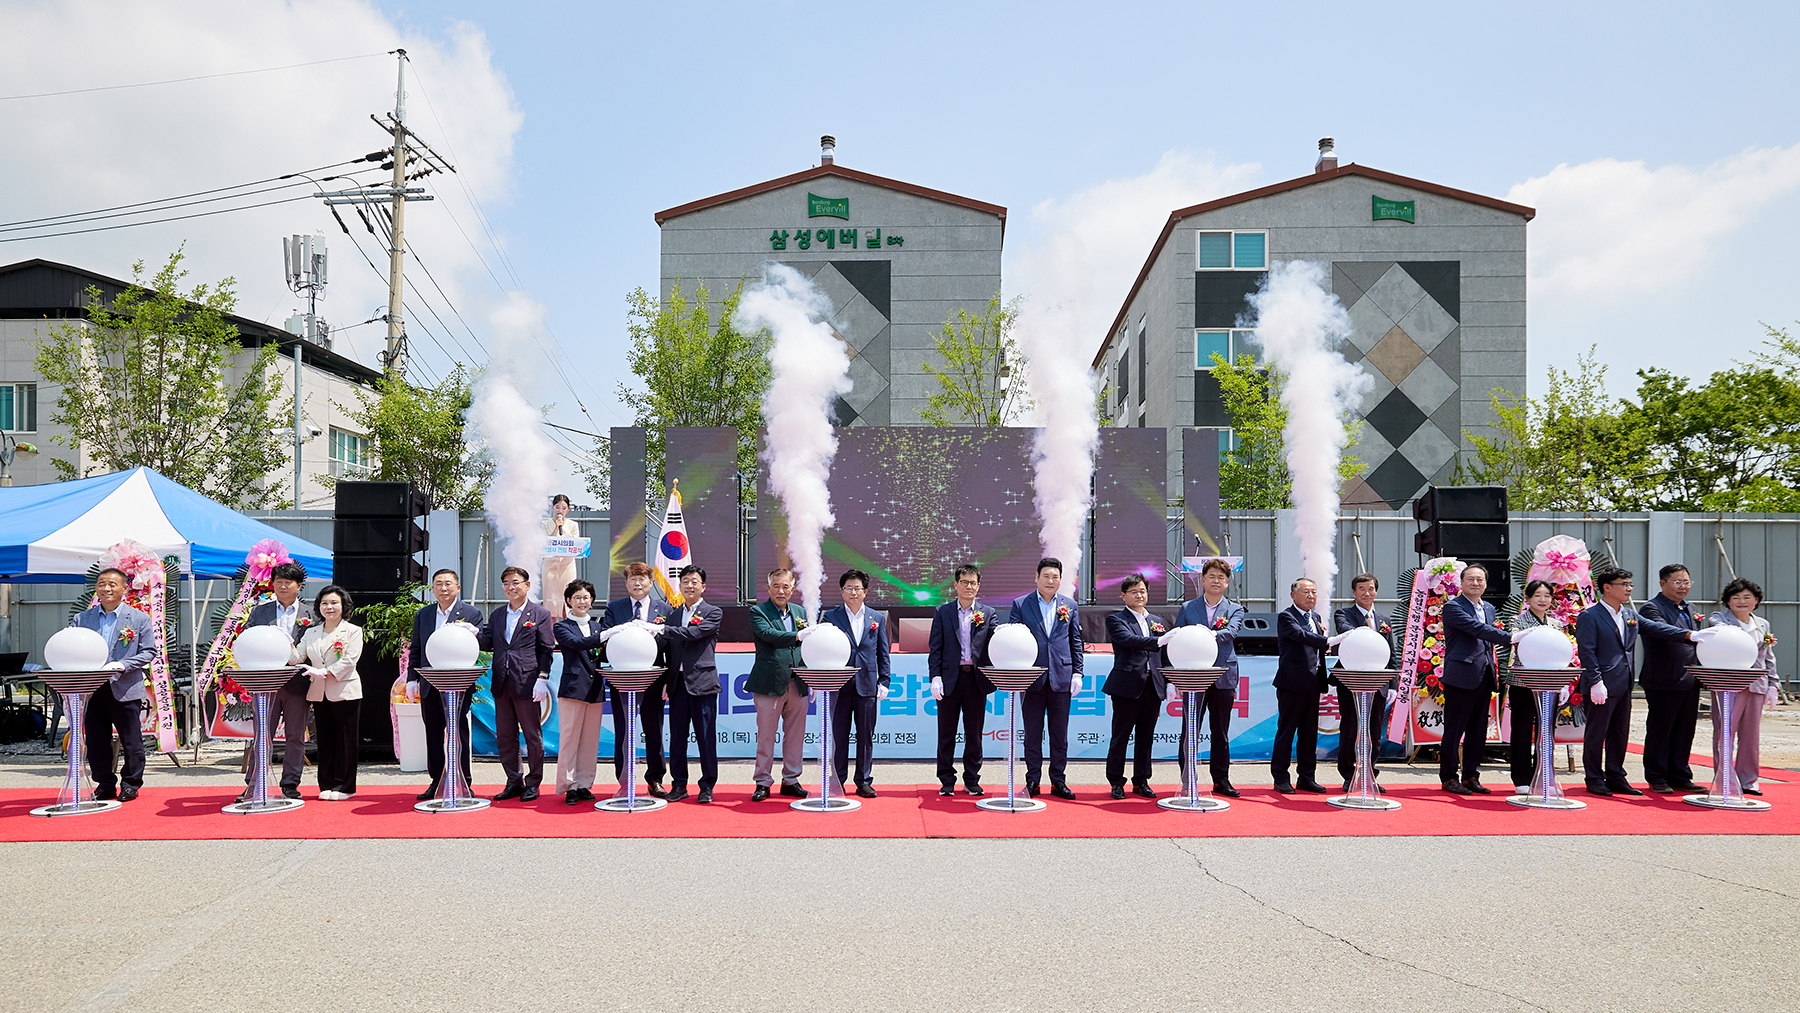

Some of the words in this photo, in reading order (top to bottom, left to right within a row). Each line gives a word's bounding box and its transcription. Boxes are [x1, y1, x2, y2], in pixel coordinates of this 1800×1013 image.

[816, 203, 846, 213] Evervill
[1381, 206, 1411, 216] Evervill
[894, 732, 917, 744] 전정
[1077, 732, 1099, 744] 주관
